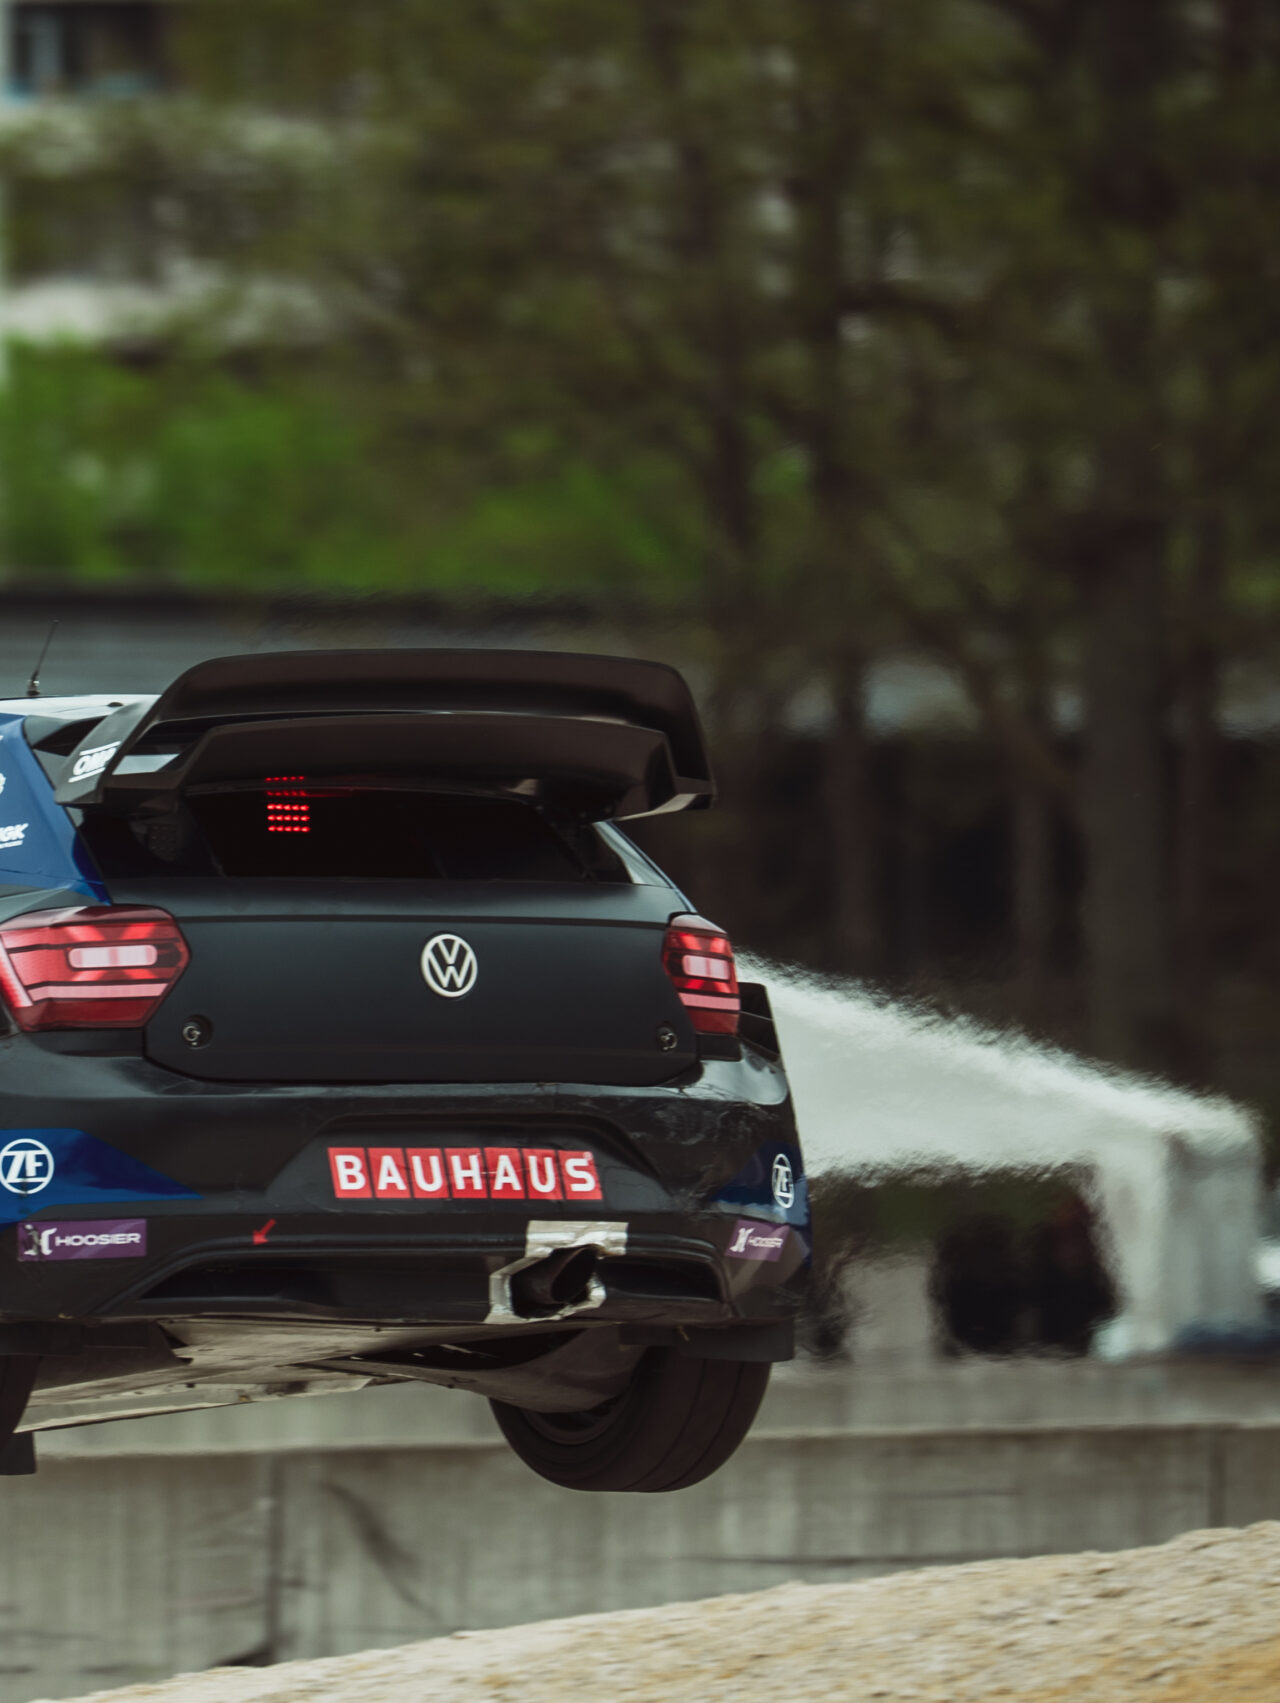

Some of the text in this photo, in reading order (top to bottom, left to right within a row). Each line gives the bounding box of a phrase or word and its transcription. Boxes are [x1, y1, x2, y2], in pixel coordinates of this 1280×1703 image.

[0, 1146, 51, 1187] ZF
[333, 1153, 596, 1193] BAUHAUS
[55, 1232, 141, 1248] HOOSIER
